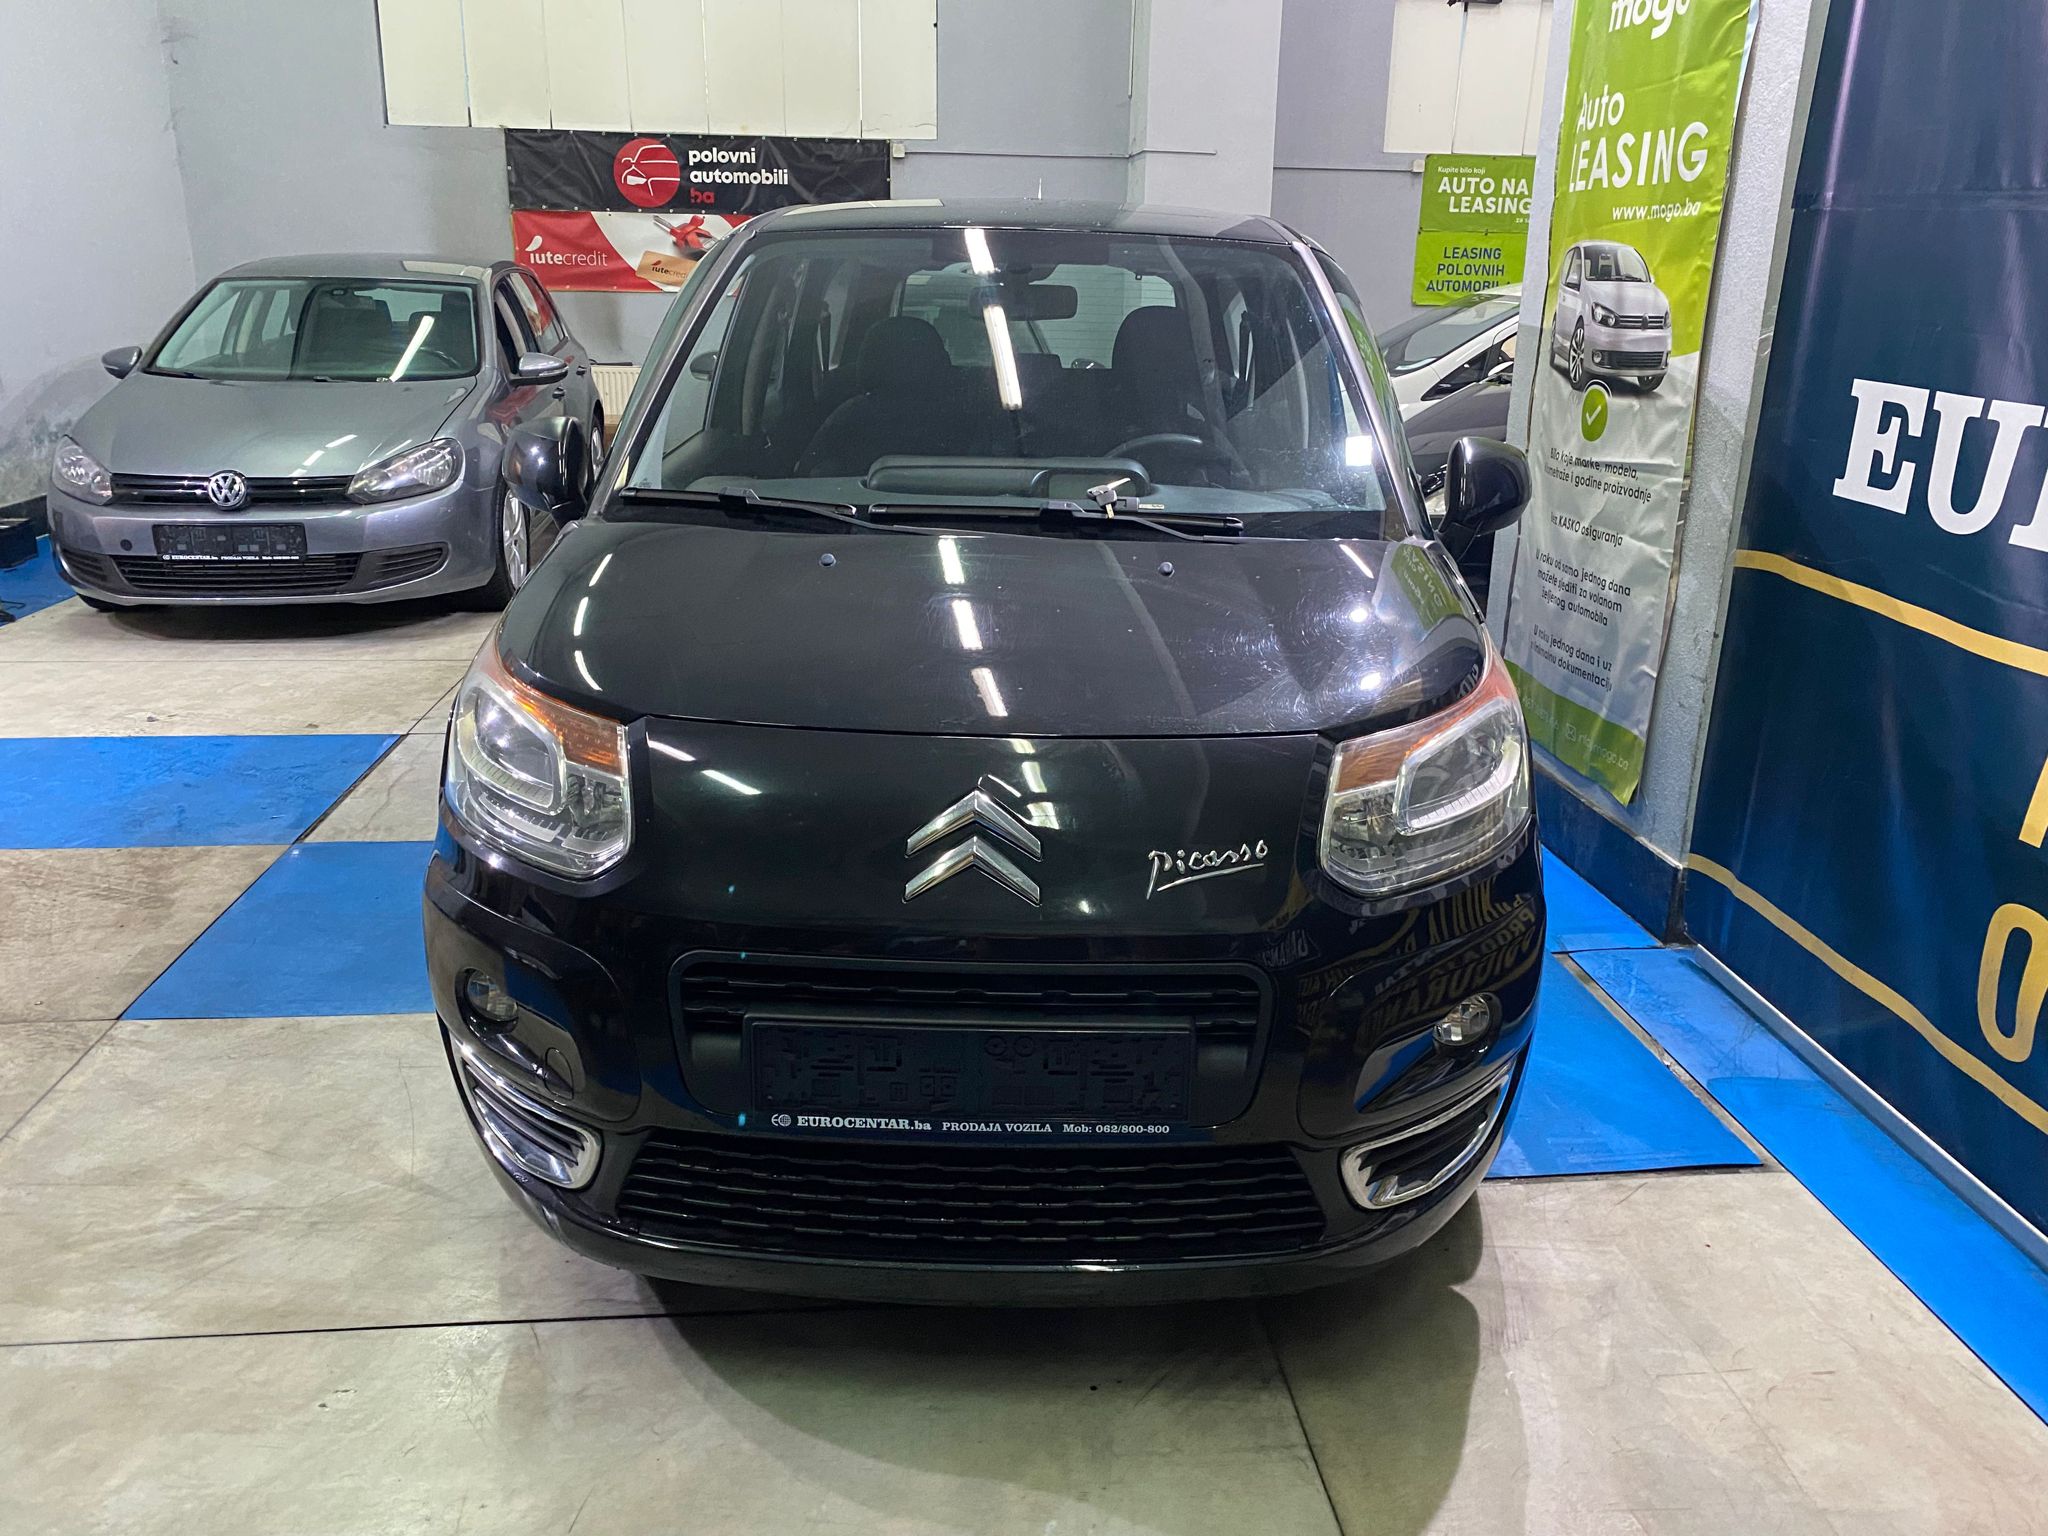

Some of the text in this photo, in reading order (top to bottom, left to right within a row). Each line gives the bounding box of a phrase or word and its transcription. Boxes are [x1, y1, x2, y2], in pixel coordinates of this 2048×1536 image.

[1577, 84, 1625, 133] Auto
[688, 147, 757, 166] polovni
[1569, 121, 1709, 193] LEASING
[689, 168, 789, 186] automobili
[1437, 166, 1459, 174] Kupite
[1474, 167, 1486, 175] koji
[1438, 176, 1529, 195] AUTO NA
[1449, 196, 1532, 214] LEASING
[1612, 197, 1702, 223] www.mogo.ba
[527, 246, 608, 268] iutecredit
[1443, 247, 1502, 260] LEASING
[1437, 263, 1505, 276] POLOVNIH
[1426, 280, 1511, 293] AUTOMOBI
[1574, 457, 1602, 472] marke,
[1604, 463, 1639, 481] modela,
[1575, 474, 1602, 490] godine
[1603, 481, 1652, 504] proizvodnje
[1559, 516, 1581, 533] KASKO
[1581, 525, 1623, 547] osiguranja
[1540, 552, 1554, 566] roku
[1580, 568, 1607, 590] jednog
[1608, 579, 1631, 597] dana
[1558, 577, 1578, 595] sjediti
[1579, 587, 1588, 599] za
[1589, 592, 1622, 613] volanom
[1567, 602, 1608, 626] automobila
[1549, 634, 1575, 658] jednog
[1576, 648, 1595, 665] dana
[1602, 661, 1613, 672] uz
[797, 1115, 1170, 1134] EUROCENTAR.ba PRODAJA VOZILA Mob: 062/800-800
